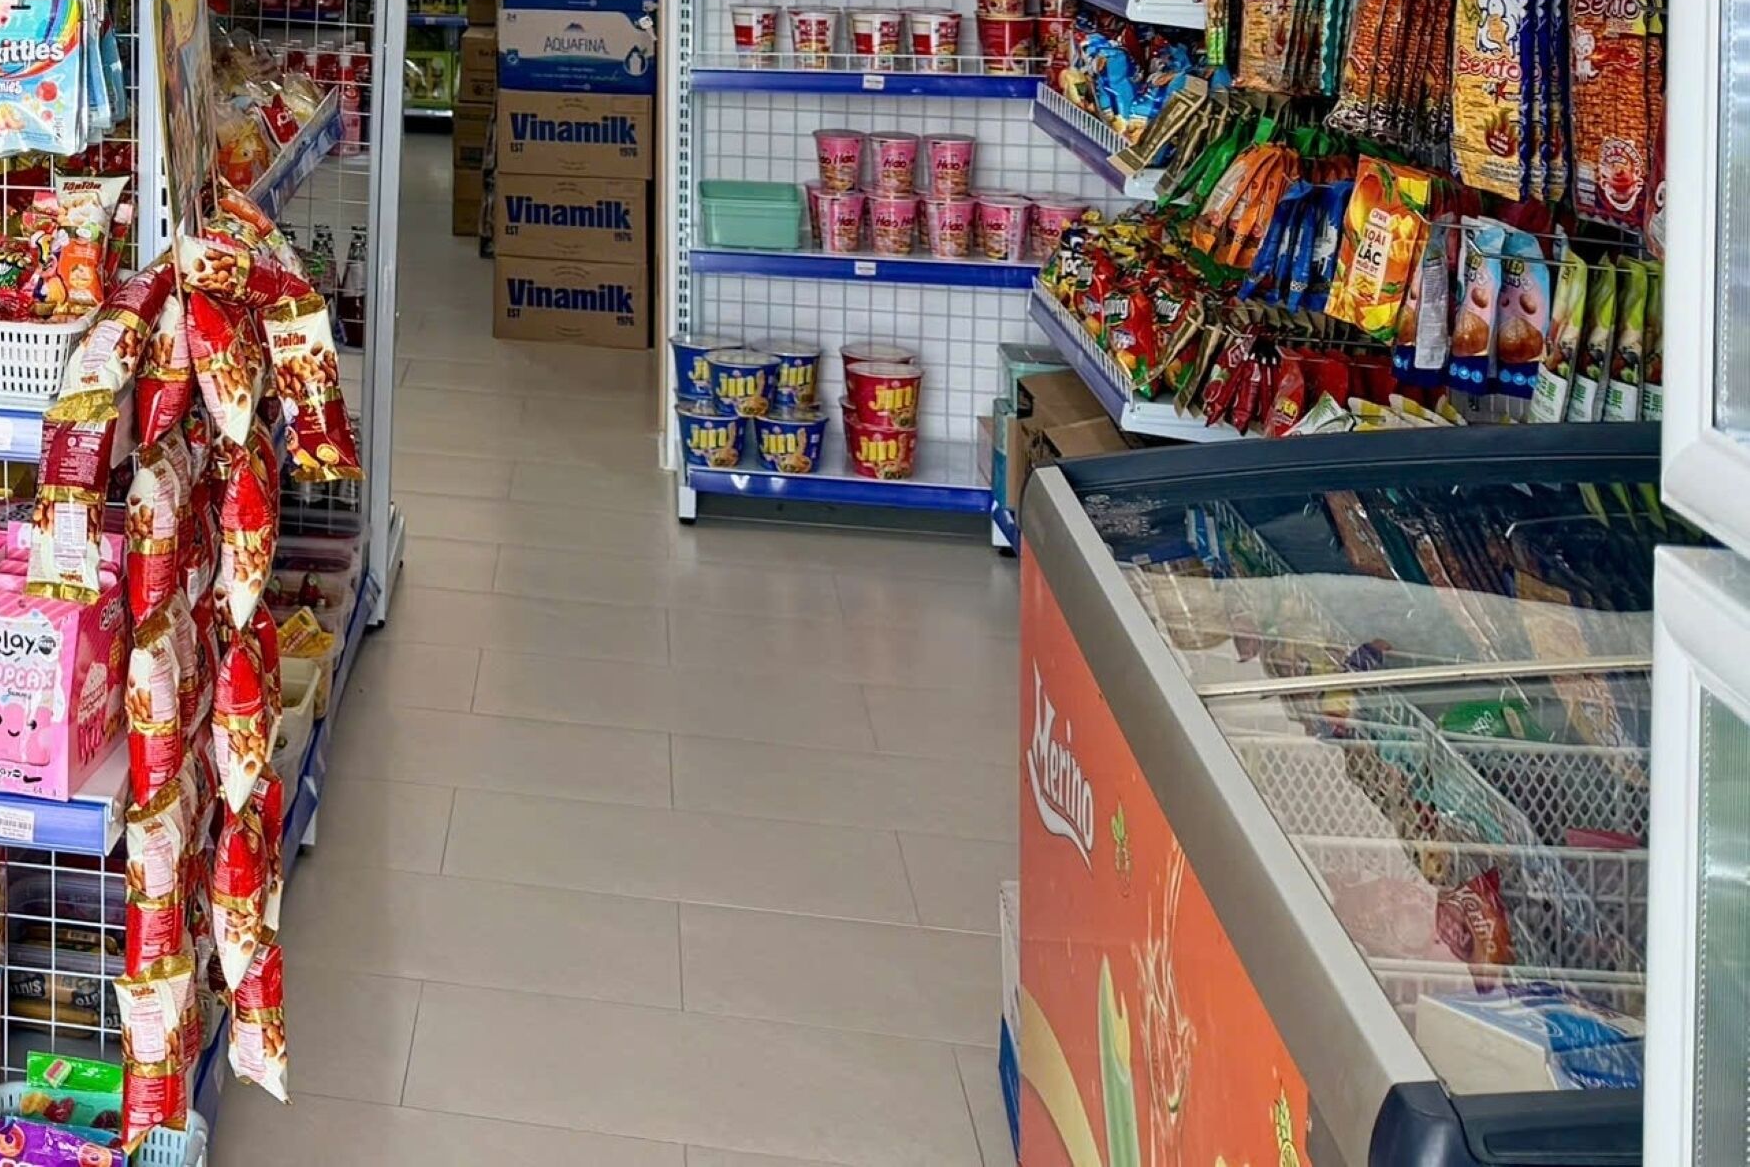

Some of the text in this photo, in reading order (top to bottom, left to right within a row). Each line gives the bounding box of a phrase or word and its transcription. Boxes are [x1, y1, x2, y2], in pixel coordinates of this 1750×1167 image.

[543, 36, 610, 55] AQUAFINA
[1457, 46, 1522, 80] Bento
[509, 112, 638, 145] Vinamilk
[504, 195, 633, 230] Vinamilk
[506, 278, 635, 314] Vinamilk
[1032, 666, 1096, 838] Merino
